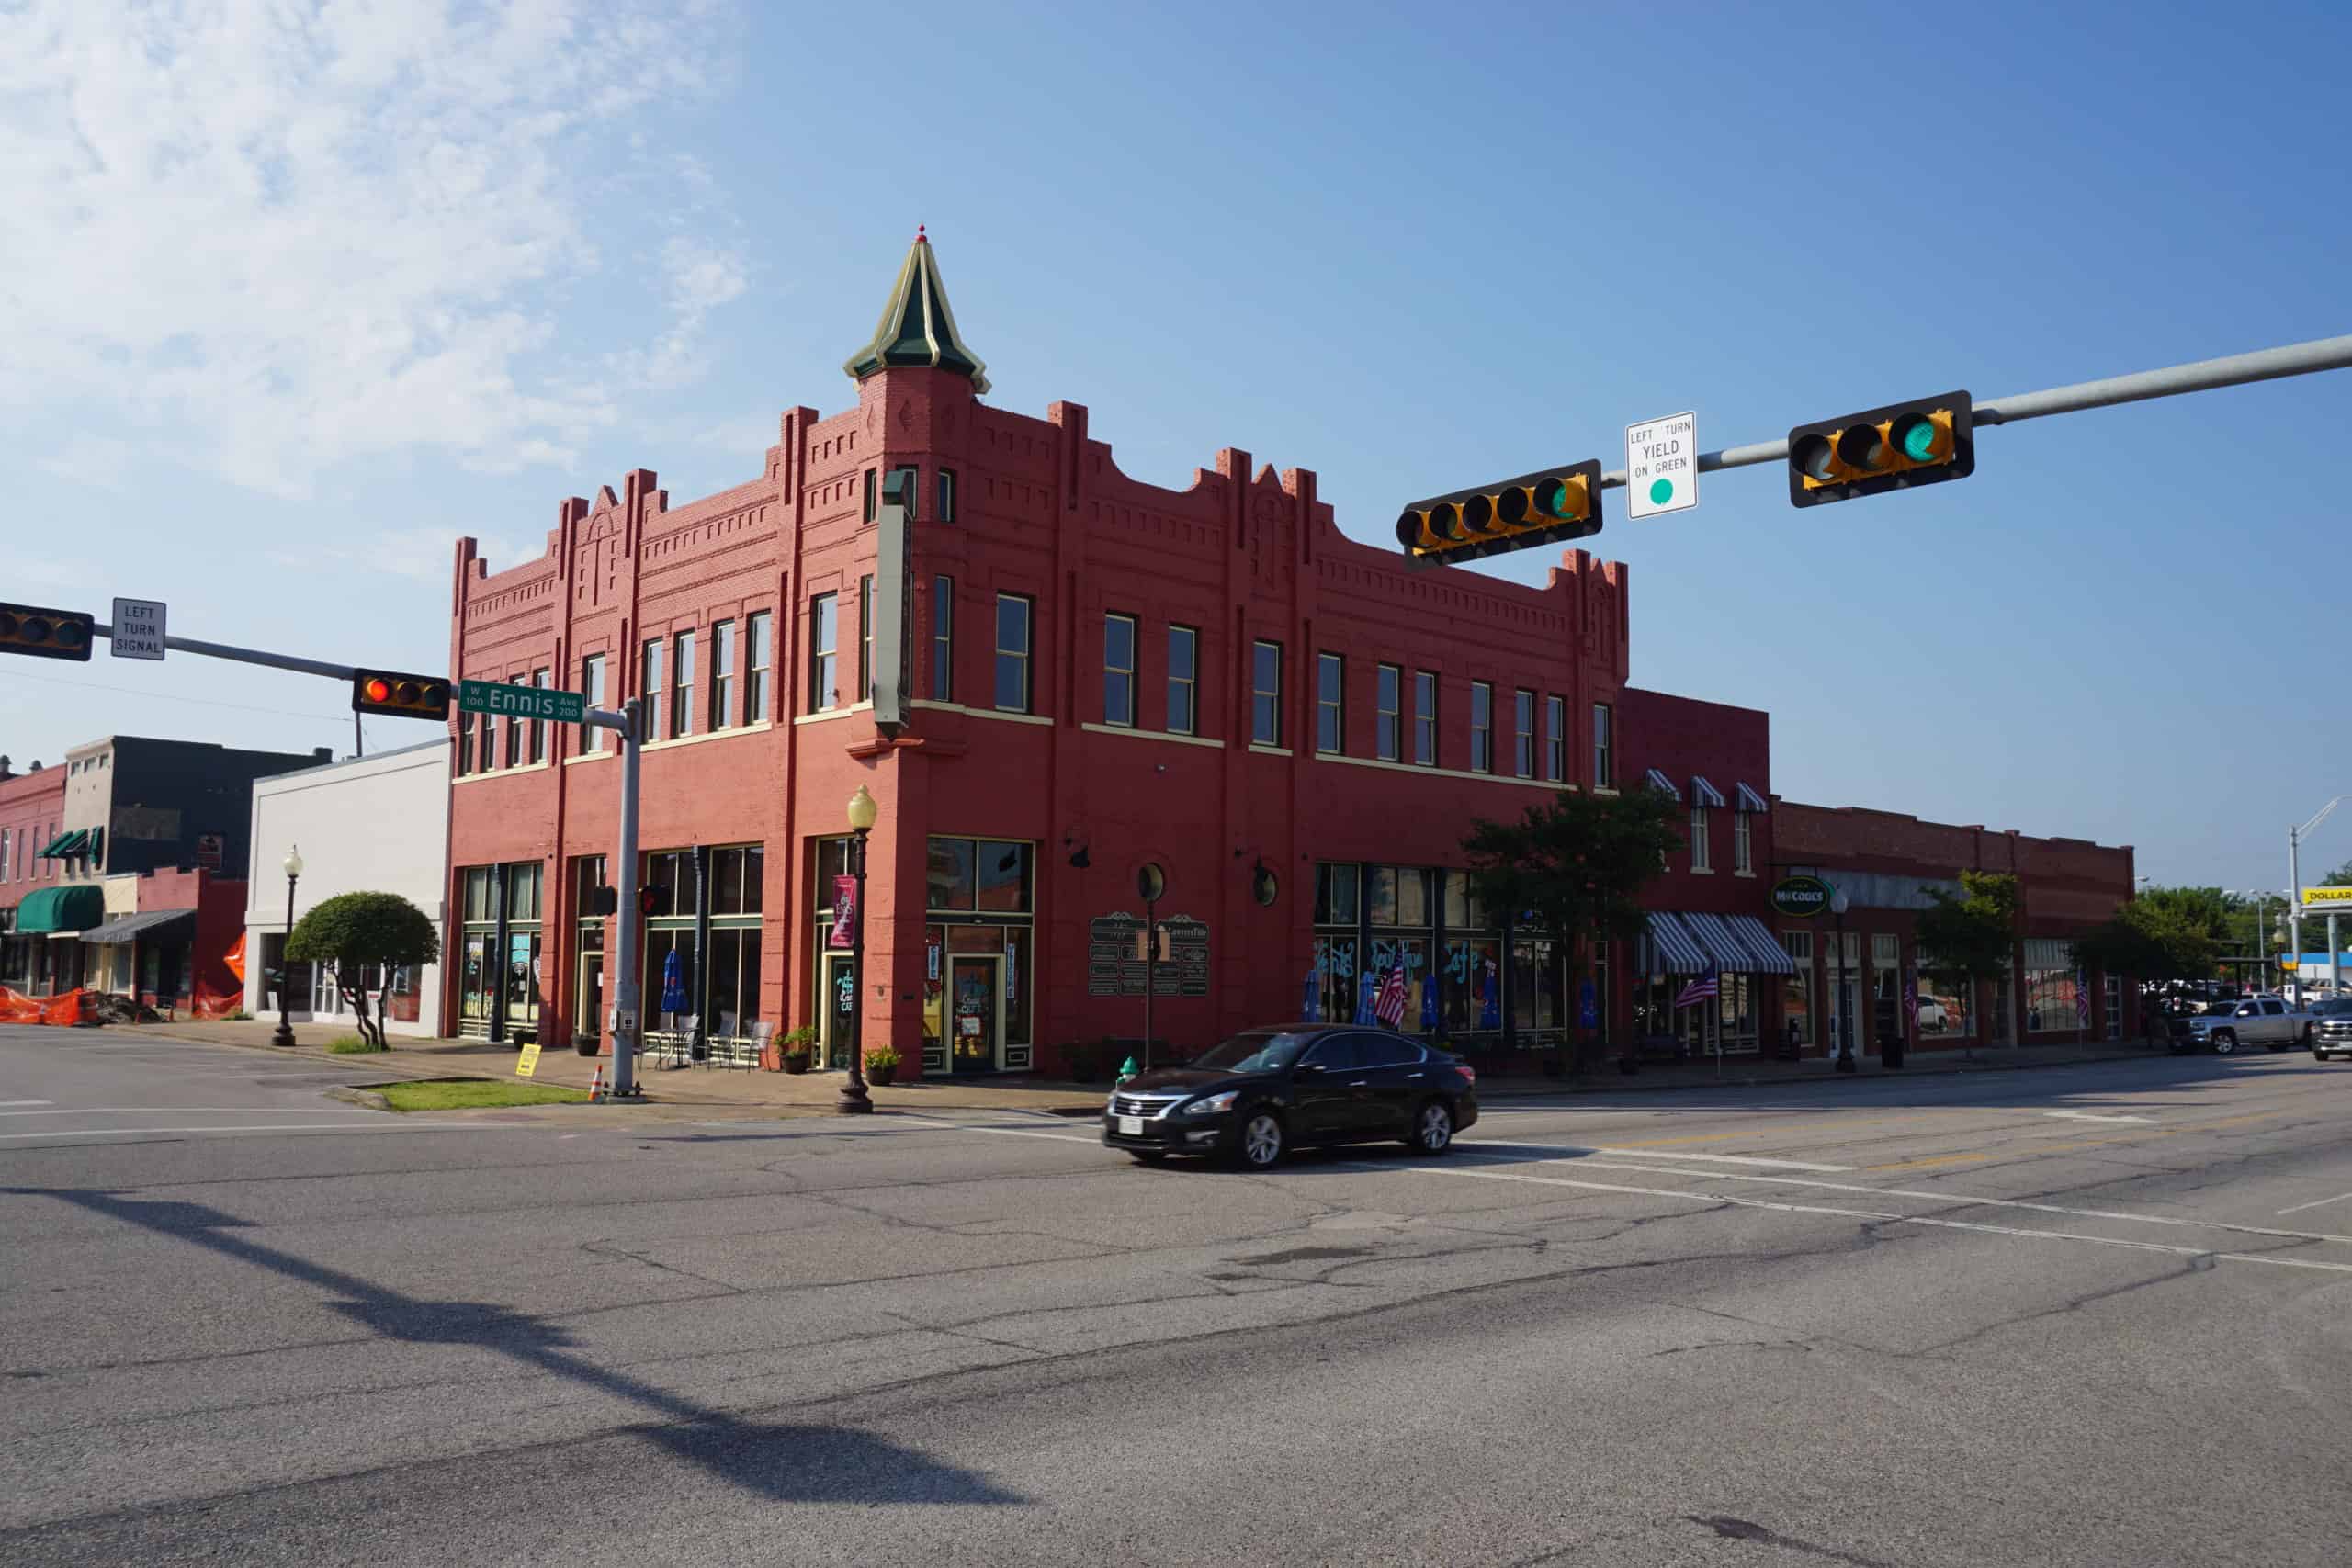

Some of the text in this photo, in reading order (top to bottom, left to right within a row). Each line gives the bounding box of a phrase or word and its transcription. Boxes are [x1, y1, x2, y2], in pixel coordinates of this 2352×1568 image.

[1631, 422, 1690, 444] LEFT TURN
[1643, 440, 1679, 459] YIELD
[1635, 457, 1687, 478] ON GREEN
[125, 606, 154, 619] LEFT
[124, 622, 155, 636] TURN
[117, 638, 162, 653] SIGNAL
[470, 686, 480, 695] W
[466, 697, 484, 706] 100
[489, 689, 554, 715] Ennis
[559, 698, 578, 706] Ave
[559, 707, 578, 717] 200
[2310, 891, 2352, 900] DOLLAR
